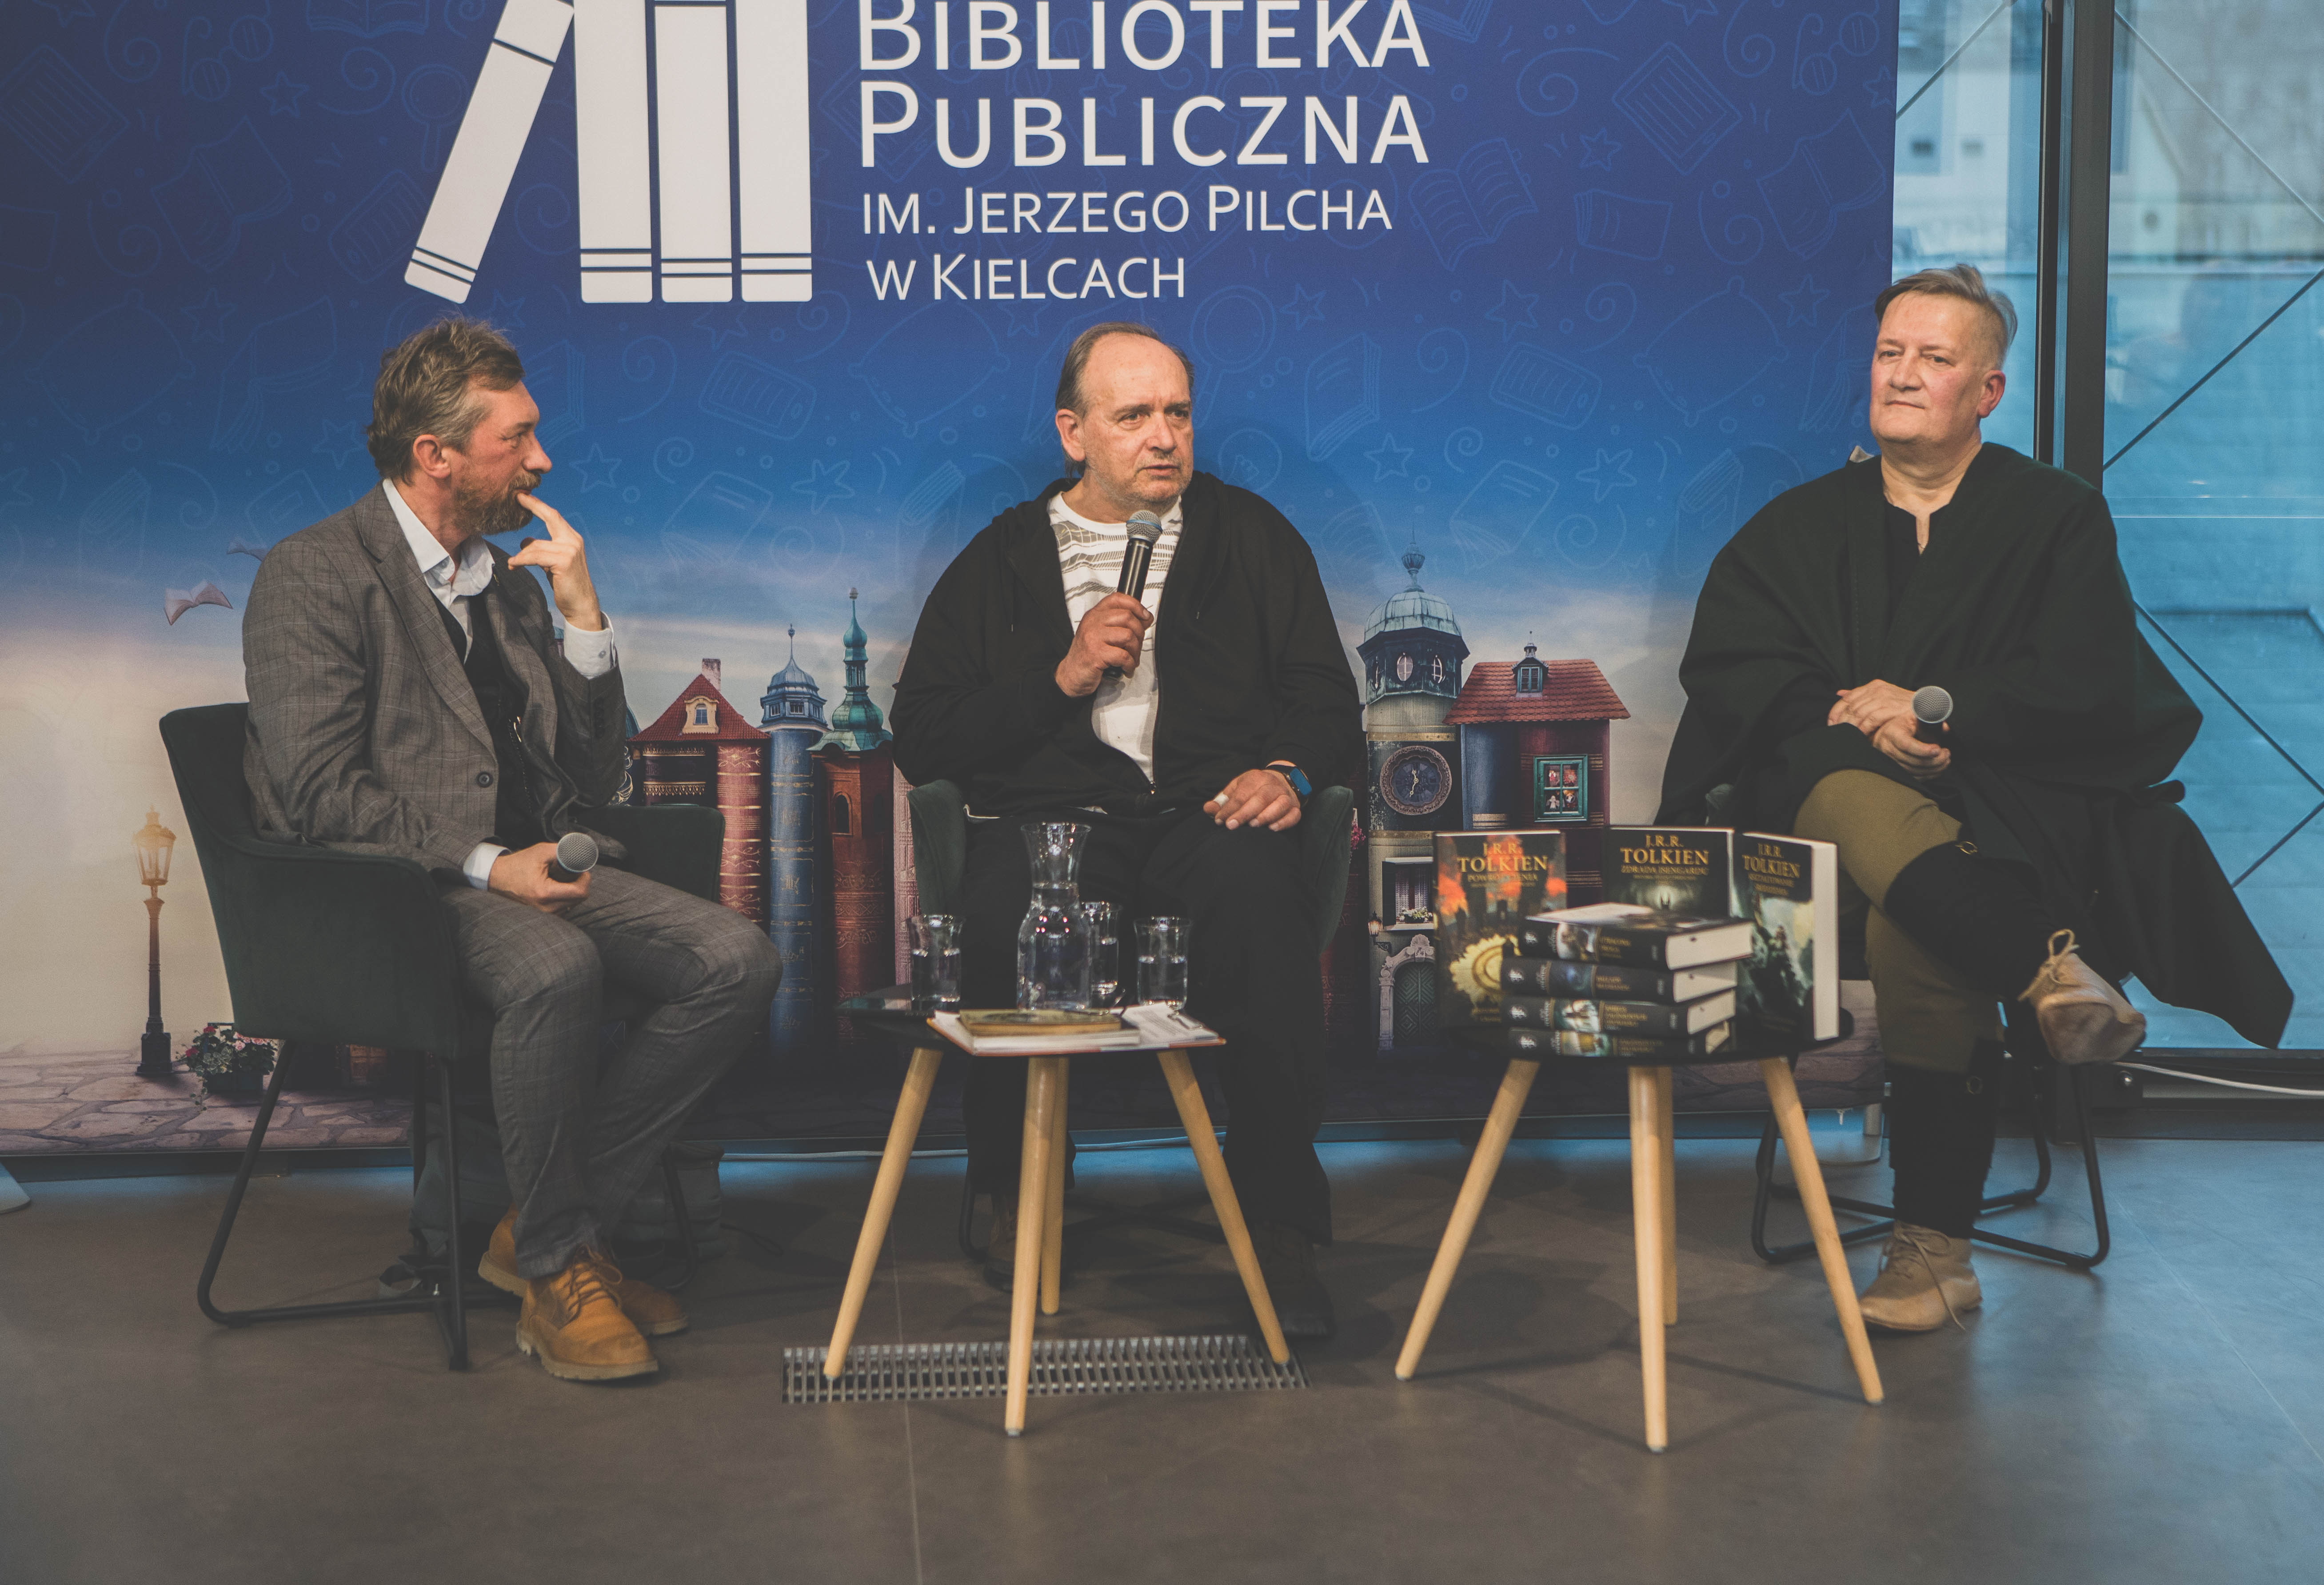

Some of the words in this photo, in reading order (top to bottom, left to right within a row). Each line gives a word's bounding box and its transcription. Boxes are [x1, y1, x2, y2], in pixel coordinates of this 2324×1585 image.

[859, 0, 1430, 70] BIBLIOTEKA
[861, 81, 1429, 168] PUBLICZNA
[864, 194, 935, 234] IM.
[954, 188, 1189, 234] JERZEGO
[1210, 186, 1392, 231] PILCHA
[934, 254, 1183, 299] KIELCACH
[1621, 848, 1709, 864] TOLKIEN
[1646, 834, 1682, 847] J.R.R.
[1457, 856, 1548, 872] TOLKIEN
[1742, 855, 1801, 878] TOLKIEN
